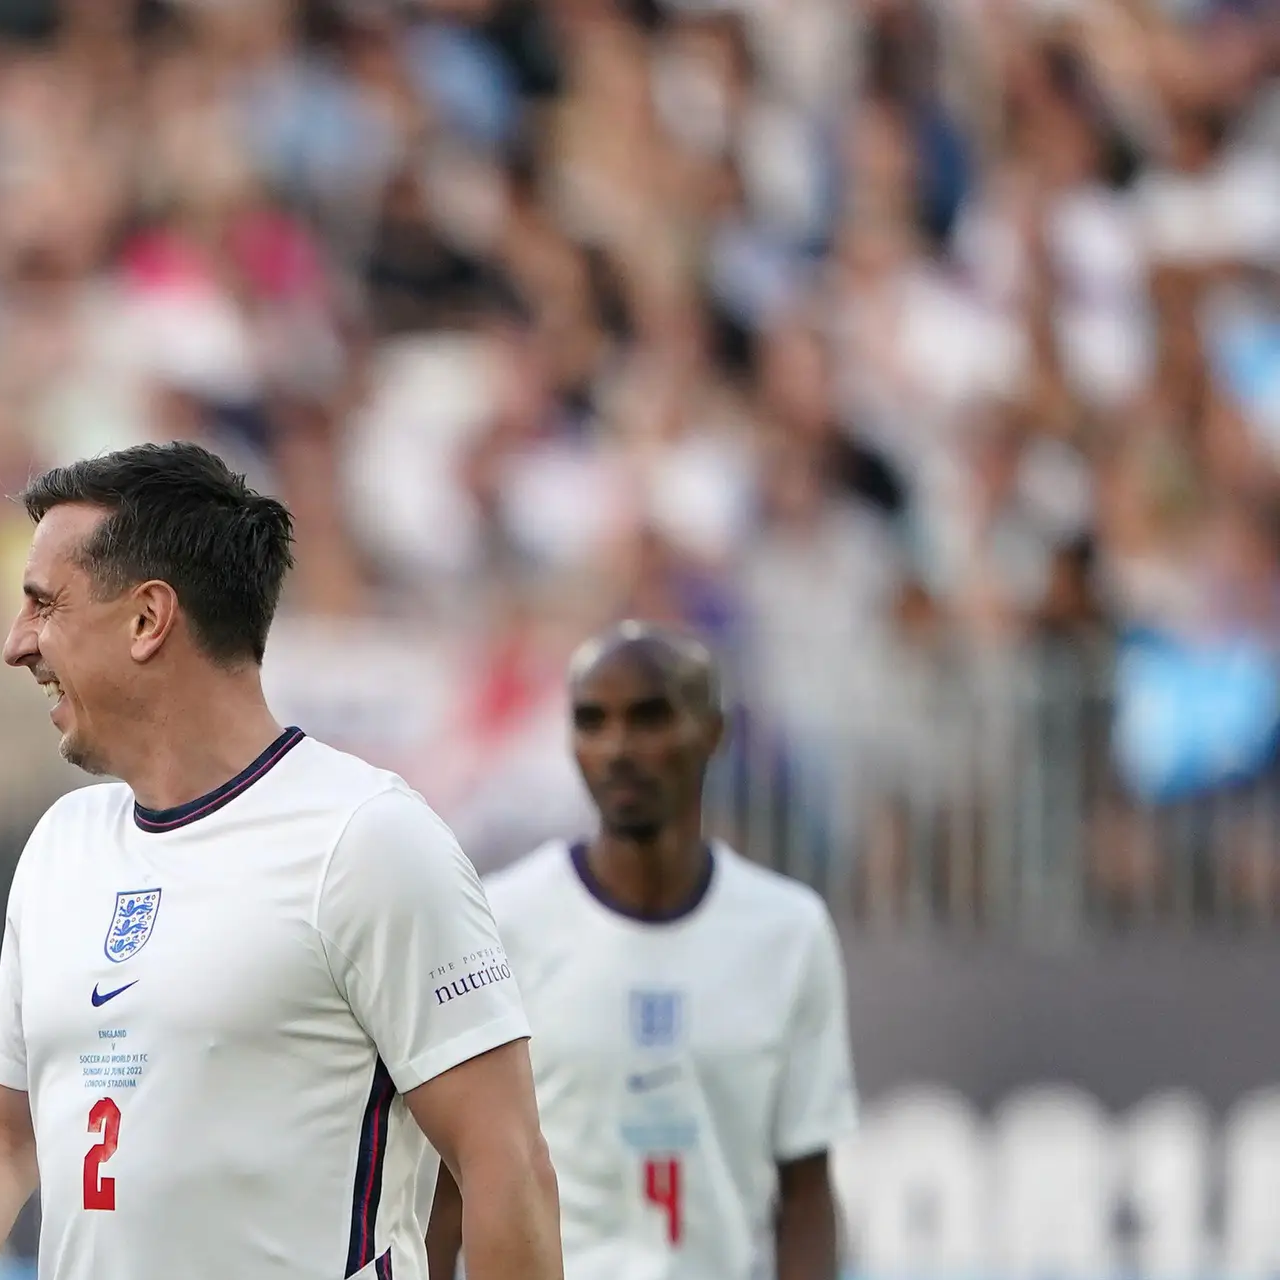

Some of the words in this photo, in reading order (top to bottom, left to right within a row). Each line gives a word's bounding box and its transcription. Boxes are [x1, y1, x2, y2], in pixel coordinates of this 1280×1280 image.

[428, 962, 455, 979] THE
[434, 958, 511, 1005] nutritio
[98, 1029, 127, 1039] ENGLAND
[79, 1054, 100, 1064] SOCCER
[111, 1054, 131, 1063] WORLD
[139, 1053, 148, 1063] FC
[110, 1066, 125, 1076] JUNE
[126, 1066, 143, 1075] 2022
[84, 1079, 106, 1088] LONDON
[107, 1079, 137, 1088] STADIUM
[83, 1097, 122, 1211] 2
[643, 1155, 682, 1248] 4
